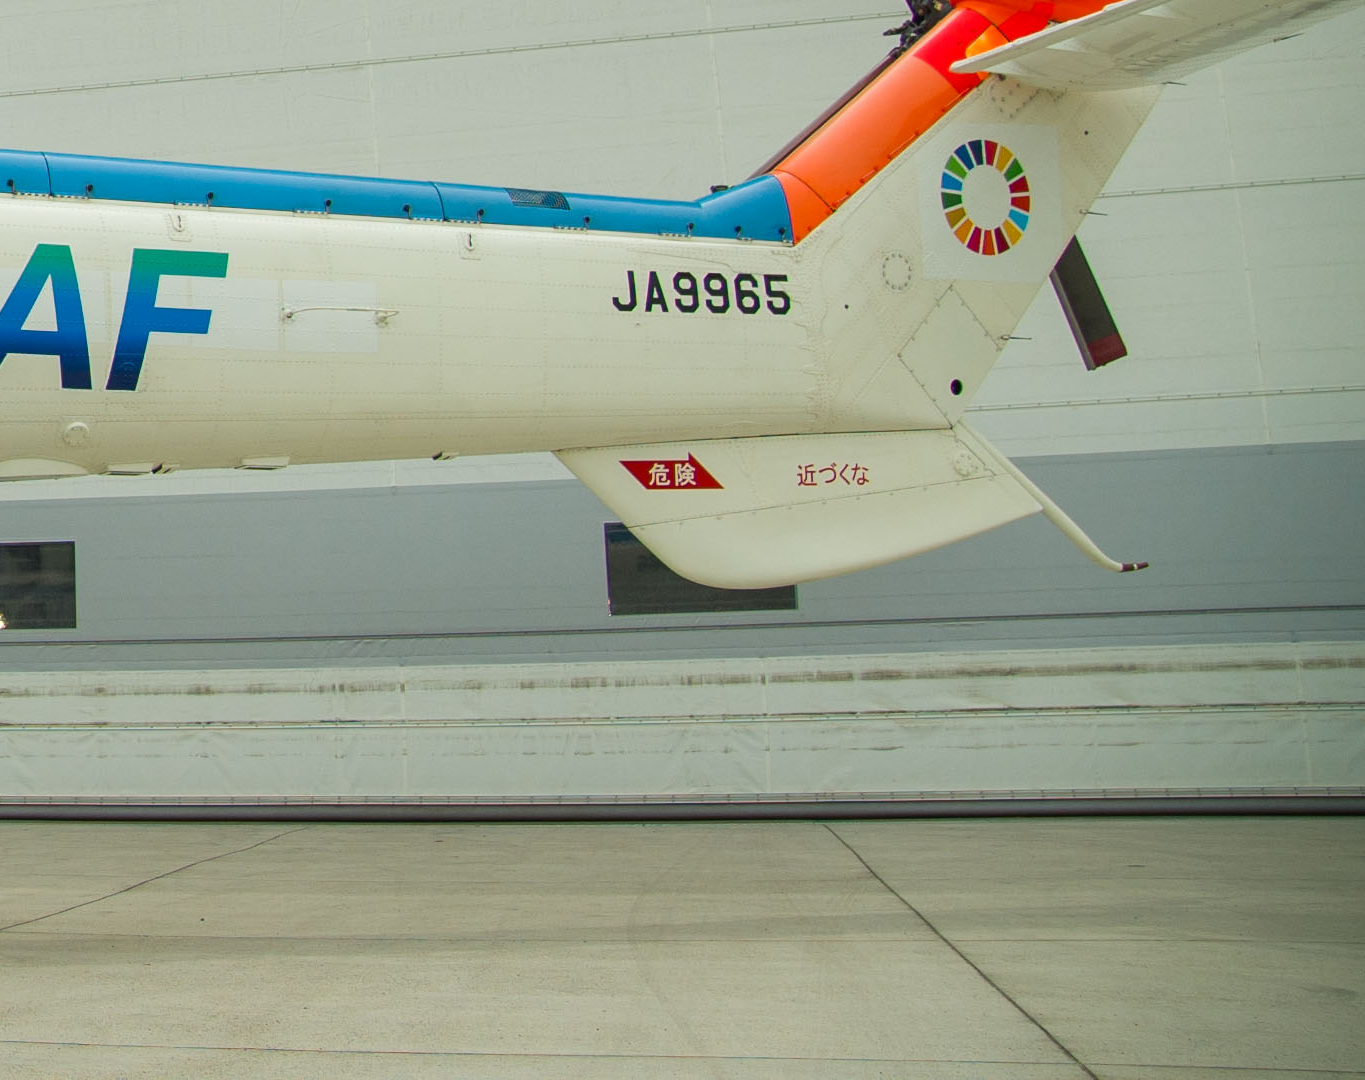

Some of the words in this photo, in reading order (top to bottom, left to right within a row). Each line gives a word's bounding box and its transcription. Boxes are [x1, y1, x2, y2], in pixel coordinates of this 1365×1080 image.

[612, 270, 792, 315] JA9965
[648, 462, 697, 487] 危険
[797, 462, 870, 487] 近づくな
